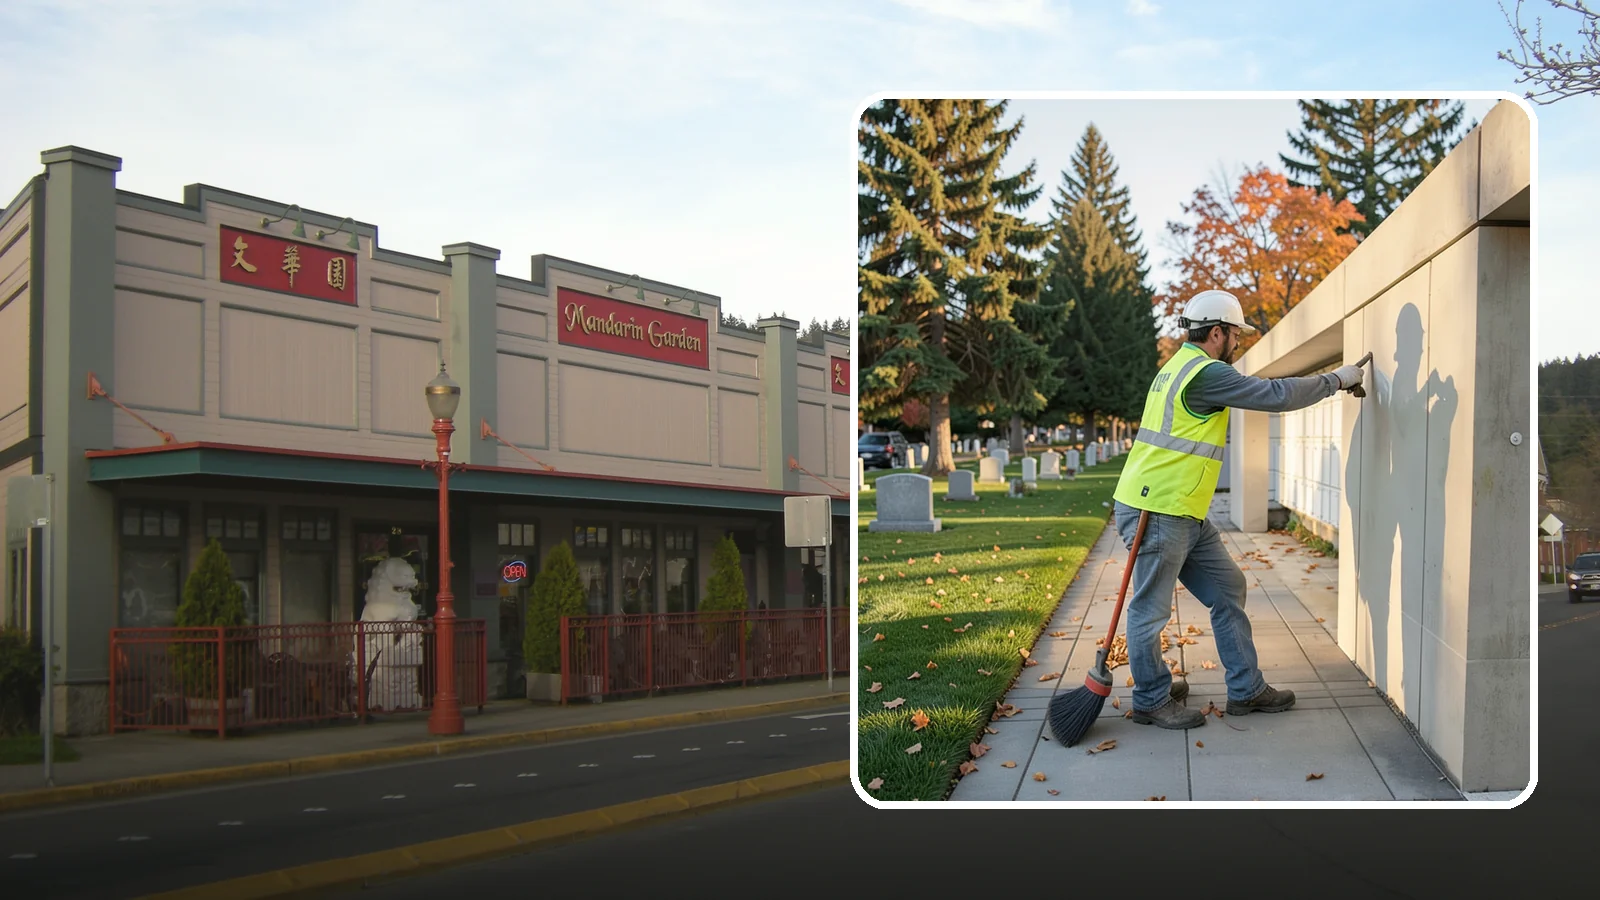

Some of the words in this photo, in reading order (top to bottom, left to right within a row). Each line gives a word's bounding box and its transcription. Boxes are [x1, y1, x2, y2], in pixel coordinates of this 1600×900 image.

[231, 236, 346, 291] 文華園
[564, 302, 644, 341] Mandarin
[648, 320, 701, 352] Garden
[503, 565, 527, 578] OPEN
